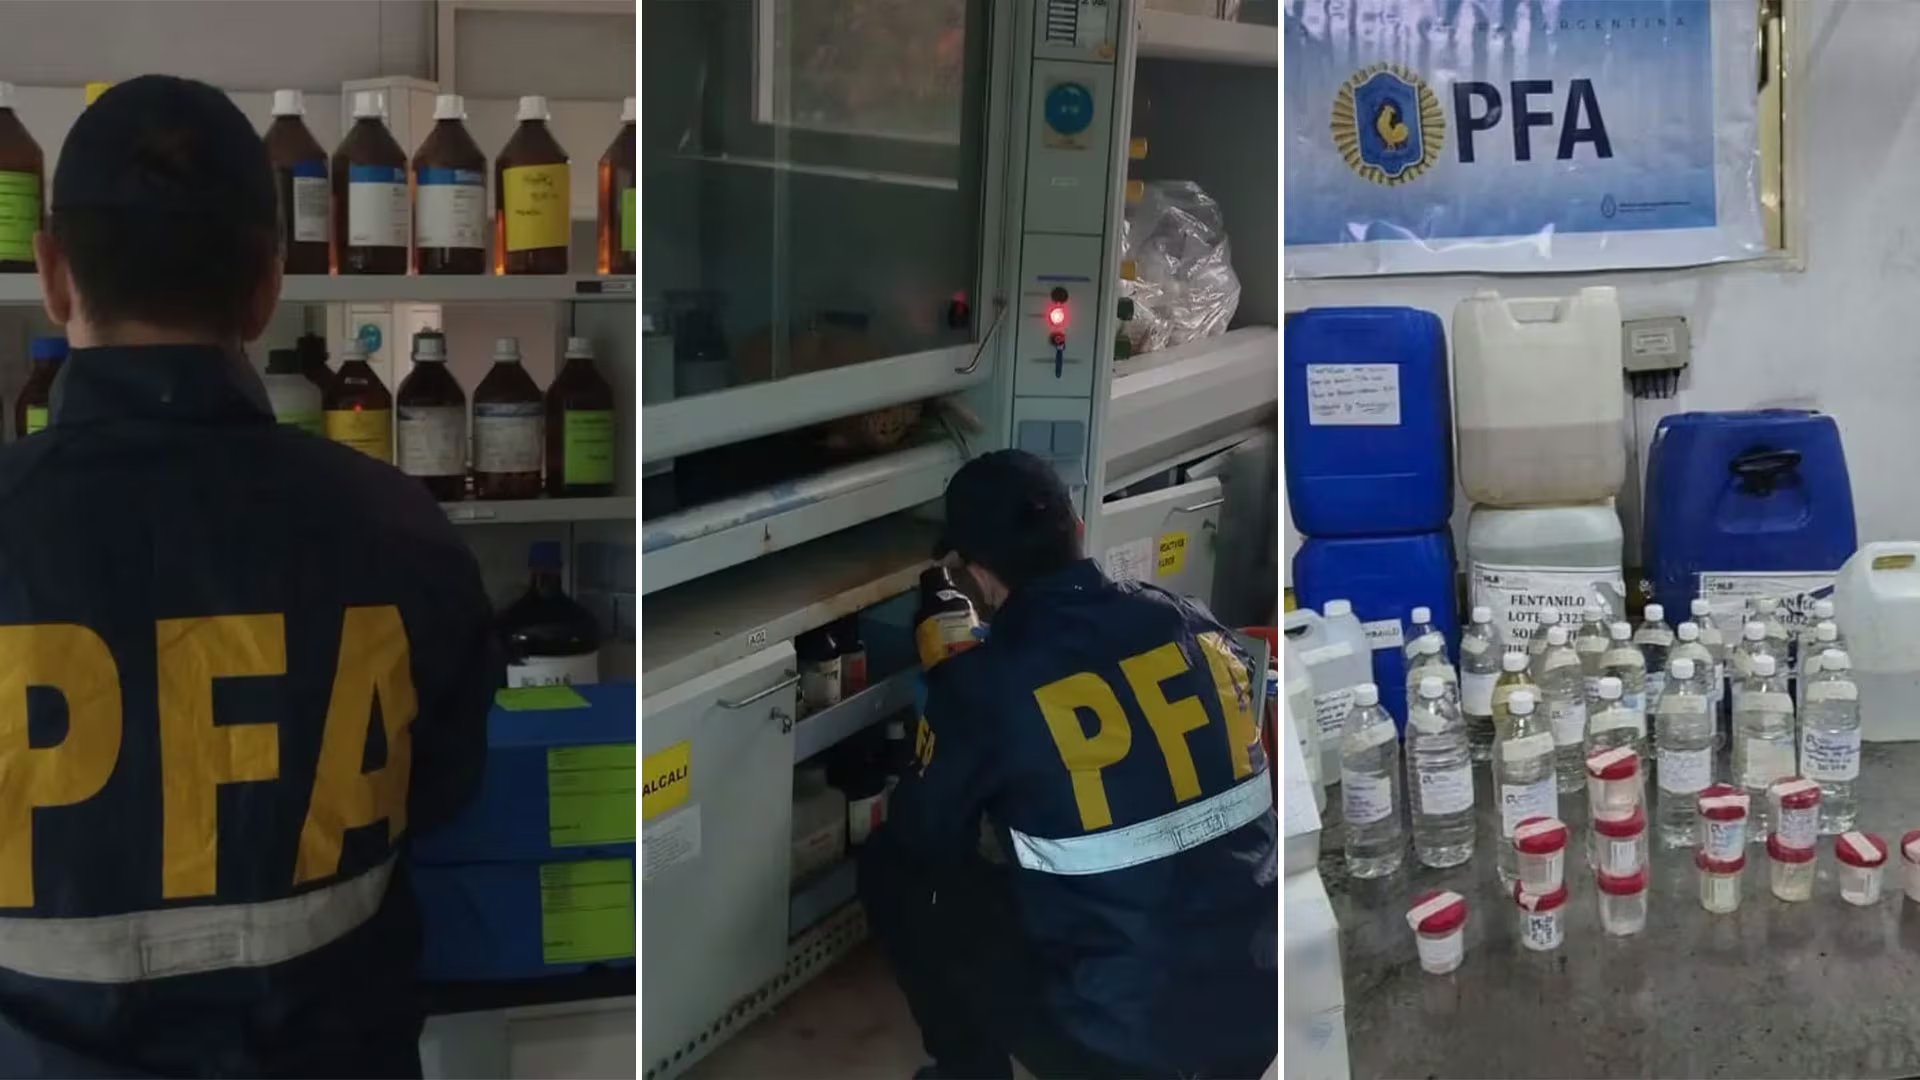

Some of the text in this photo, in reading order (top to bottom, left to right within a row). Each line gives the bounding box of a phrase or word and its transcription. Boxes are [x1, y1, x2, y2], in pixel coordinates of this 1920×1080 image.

[1453, 79, 1613, 163] PFA
[1511, 594, 1586, 607] FENTANILO
[0, 604, 419, 908] PFA
